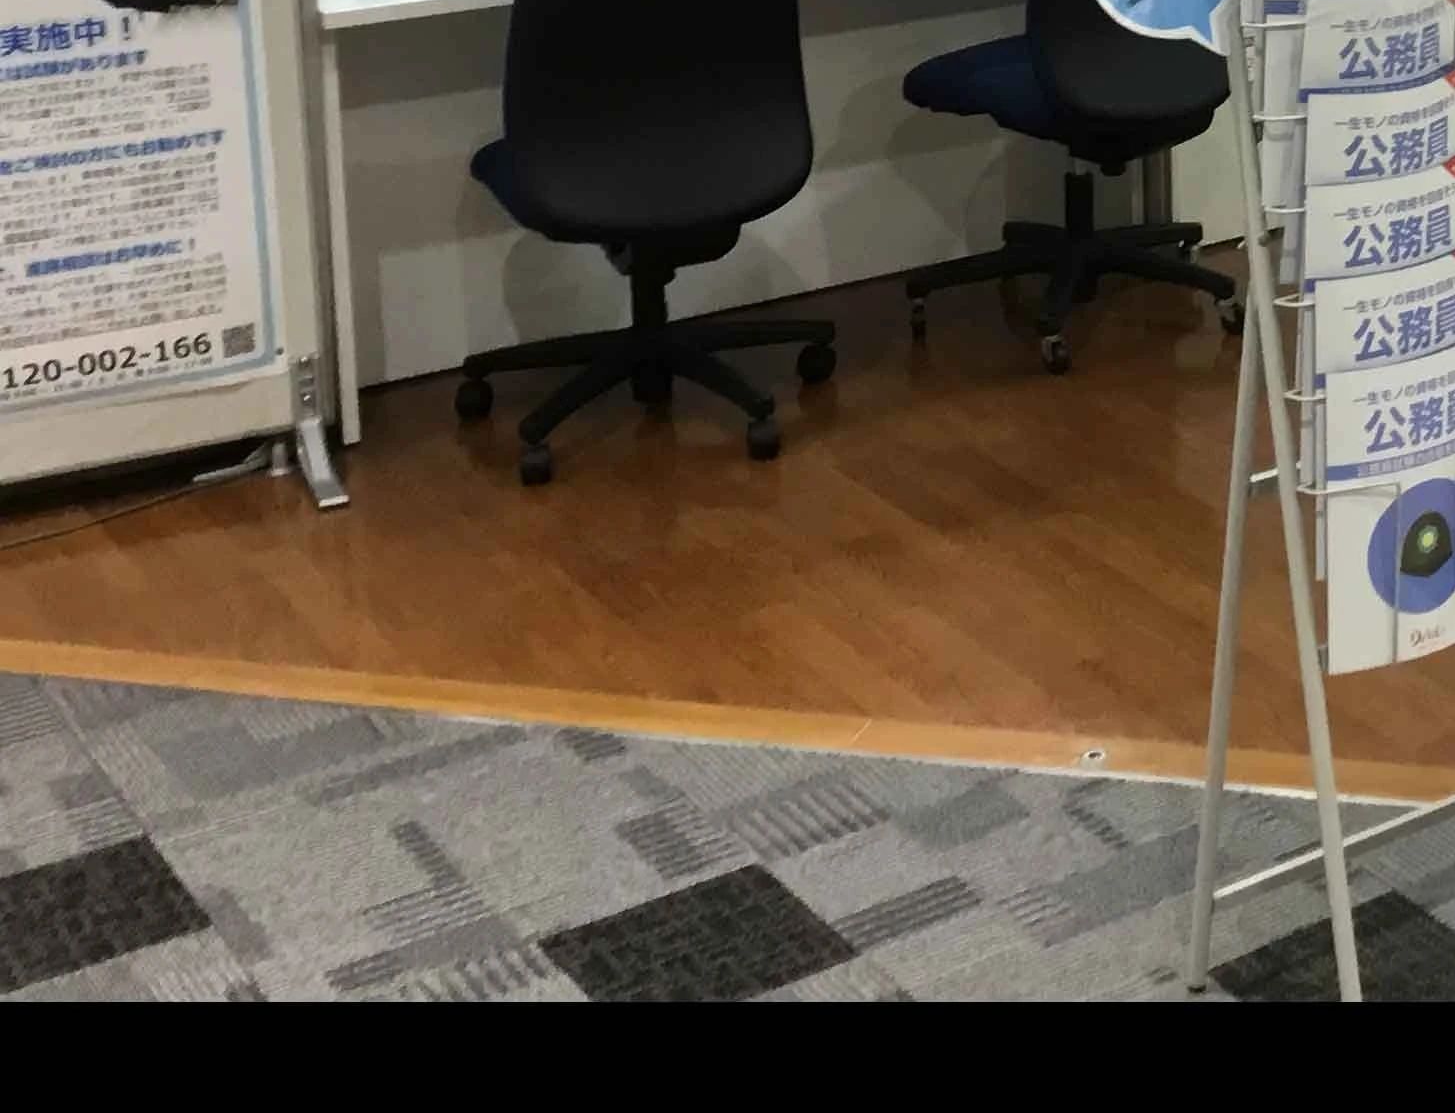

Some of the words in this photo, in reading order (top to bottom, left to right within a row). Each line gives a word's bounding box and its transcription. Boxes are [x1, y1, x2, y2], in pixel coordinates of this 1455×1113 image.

[1338, 22, 1441, 81] 公務員
[1344, 116, 1449, 179] 公務員
[1343, 204, 1453, 269] 公務員
[2, 332, 212, 390] 120-002-166
